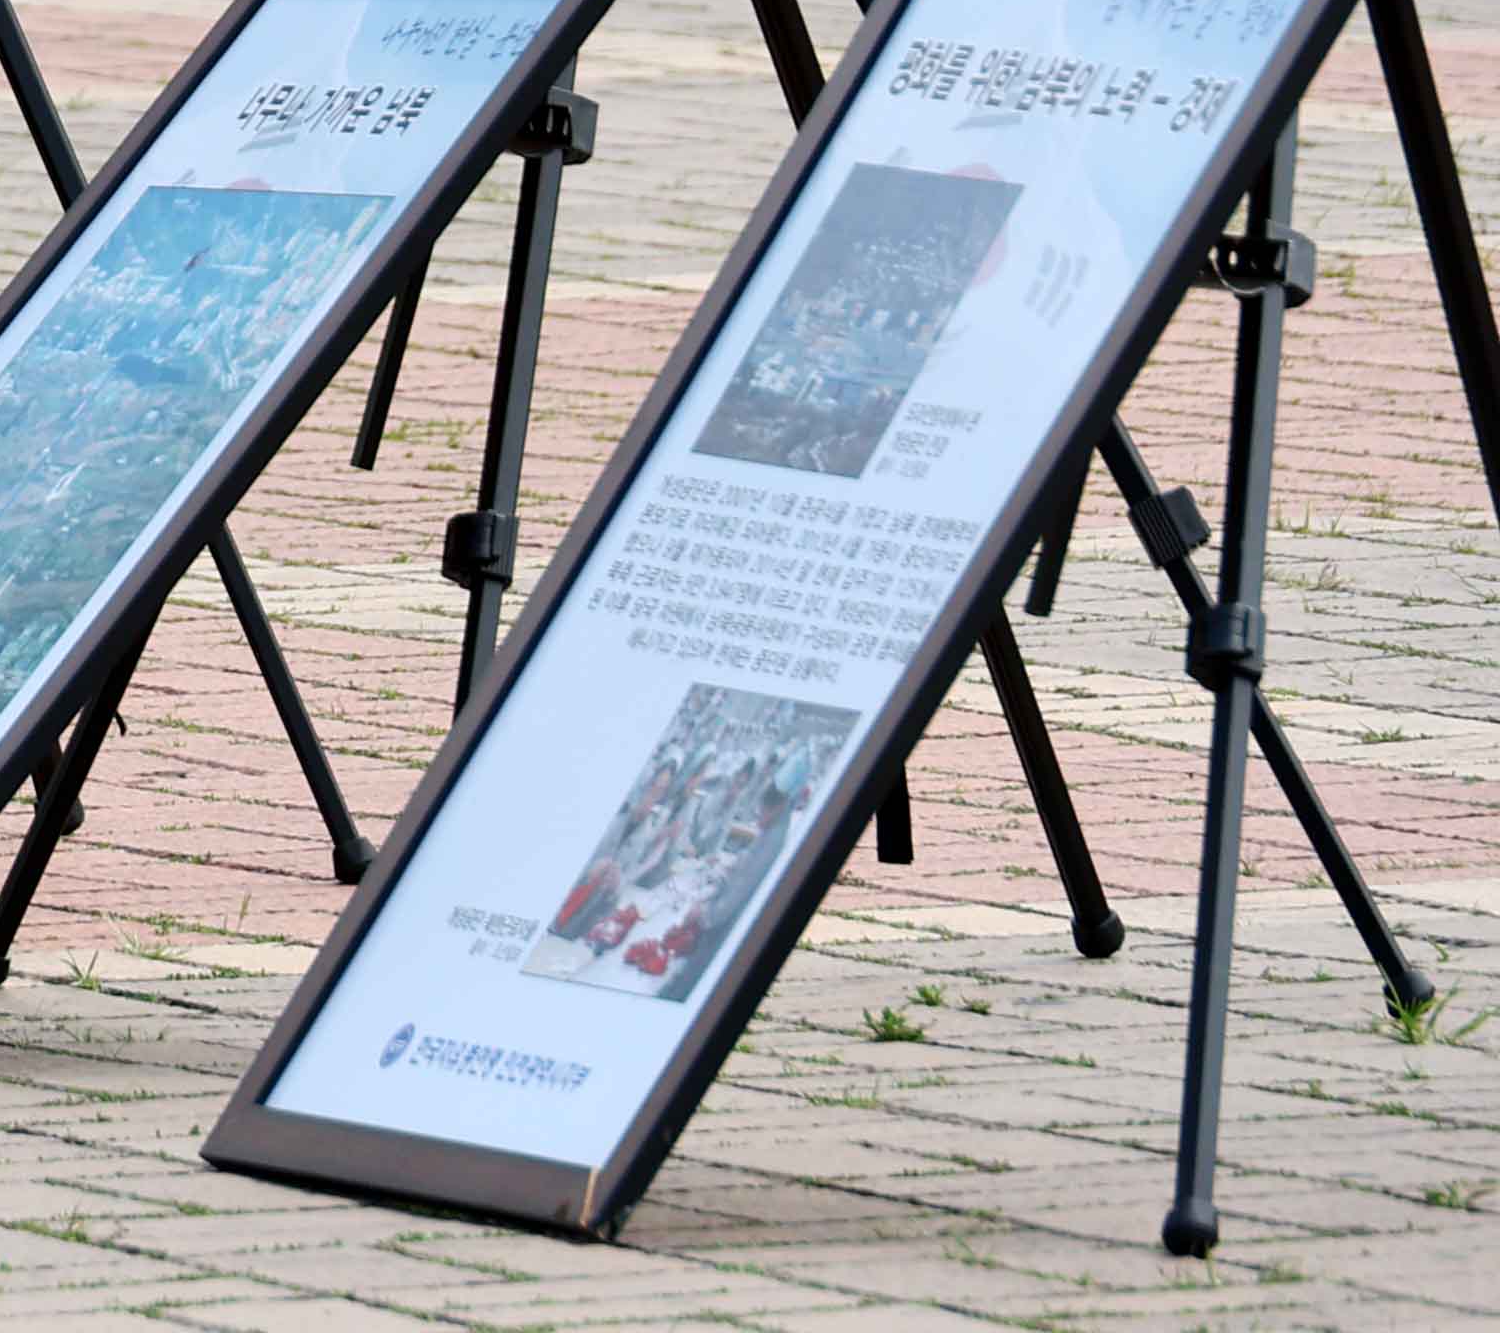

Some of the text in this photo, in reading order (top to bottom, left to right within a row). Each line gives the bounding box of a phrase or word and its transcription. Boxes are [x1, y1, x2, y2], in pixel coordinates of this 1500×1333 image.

[238, 85, 433, 135] 너무나 가까운 남북
[889, 41, 974, 101] 평화를
[967, 49, 1028, 107] 위한
[1015, 61, 1097, 112] 남북의
[1089, 70, 1153, 117] 노력
[1169, 77, 1236, 134] 경제
